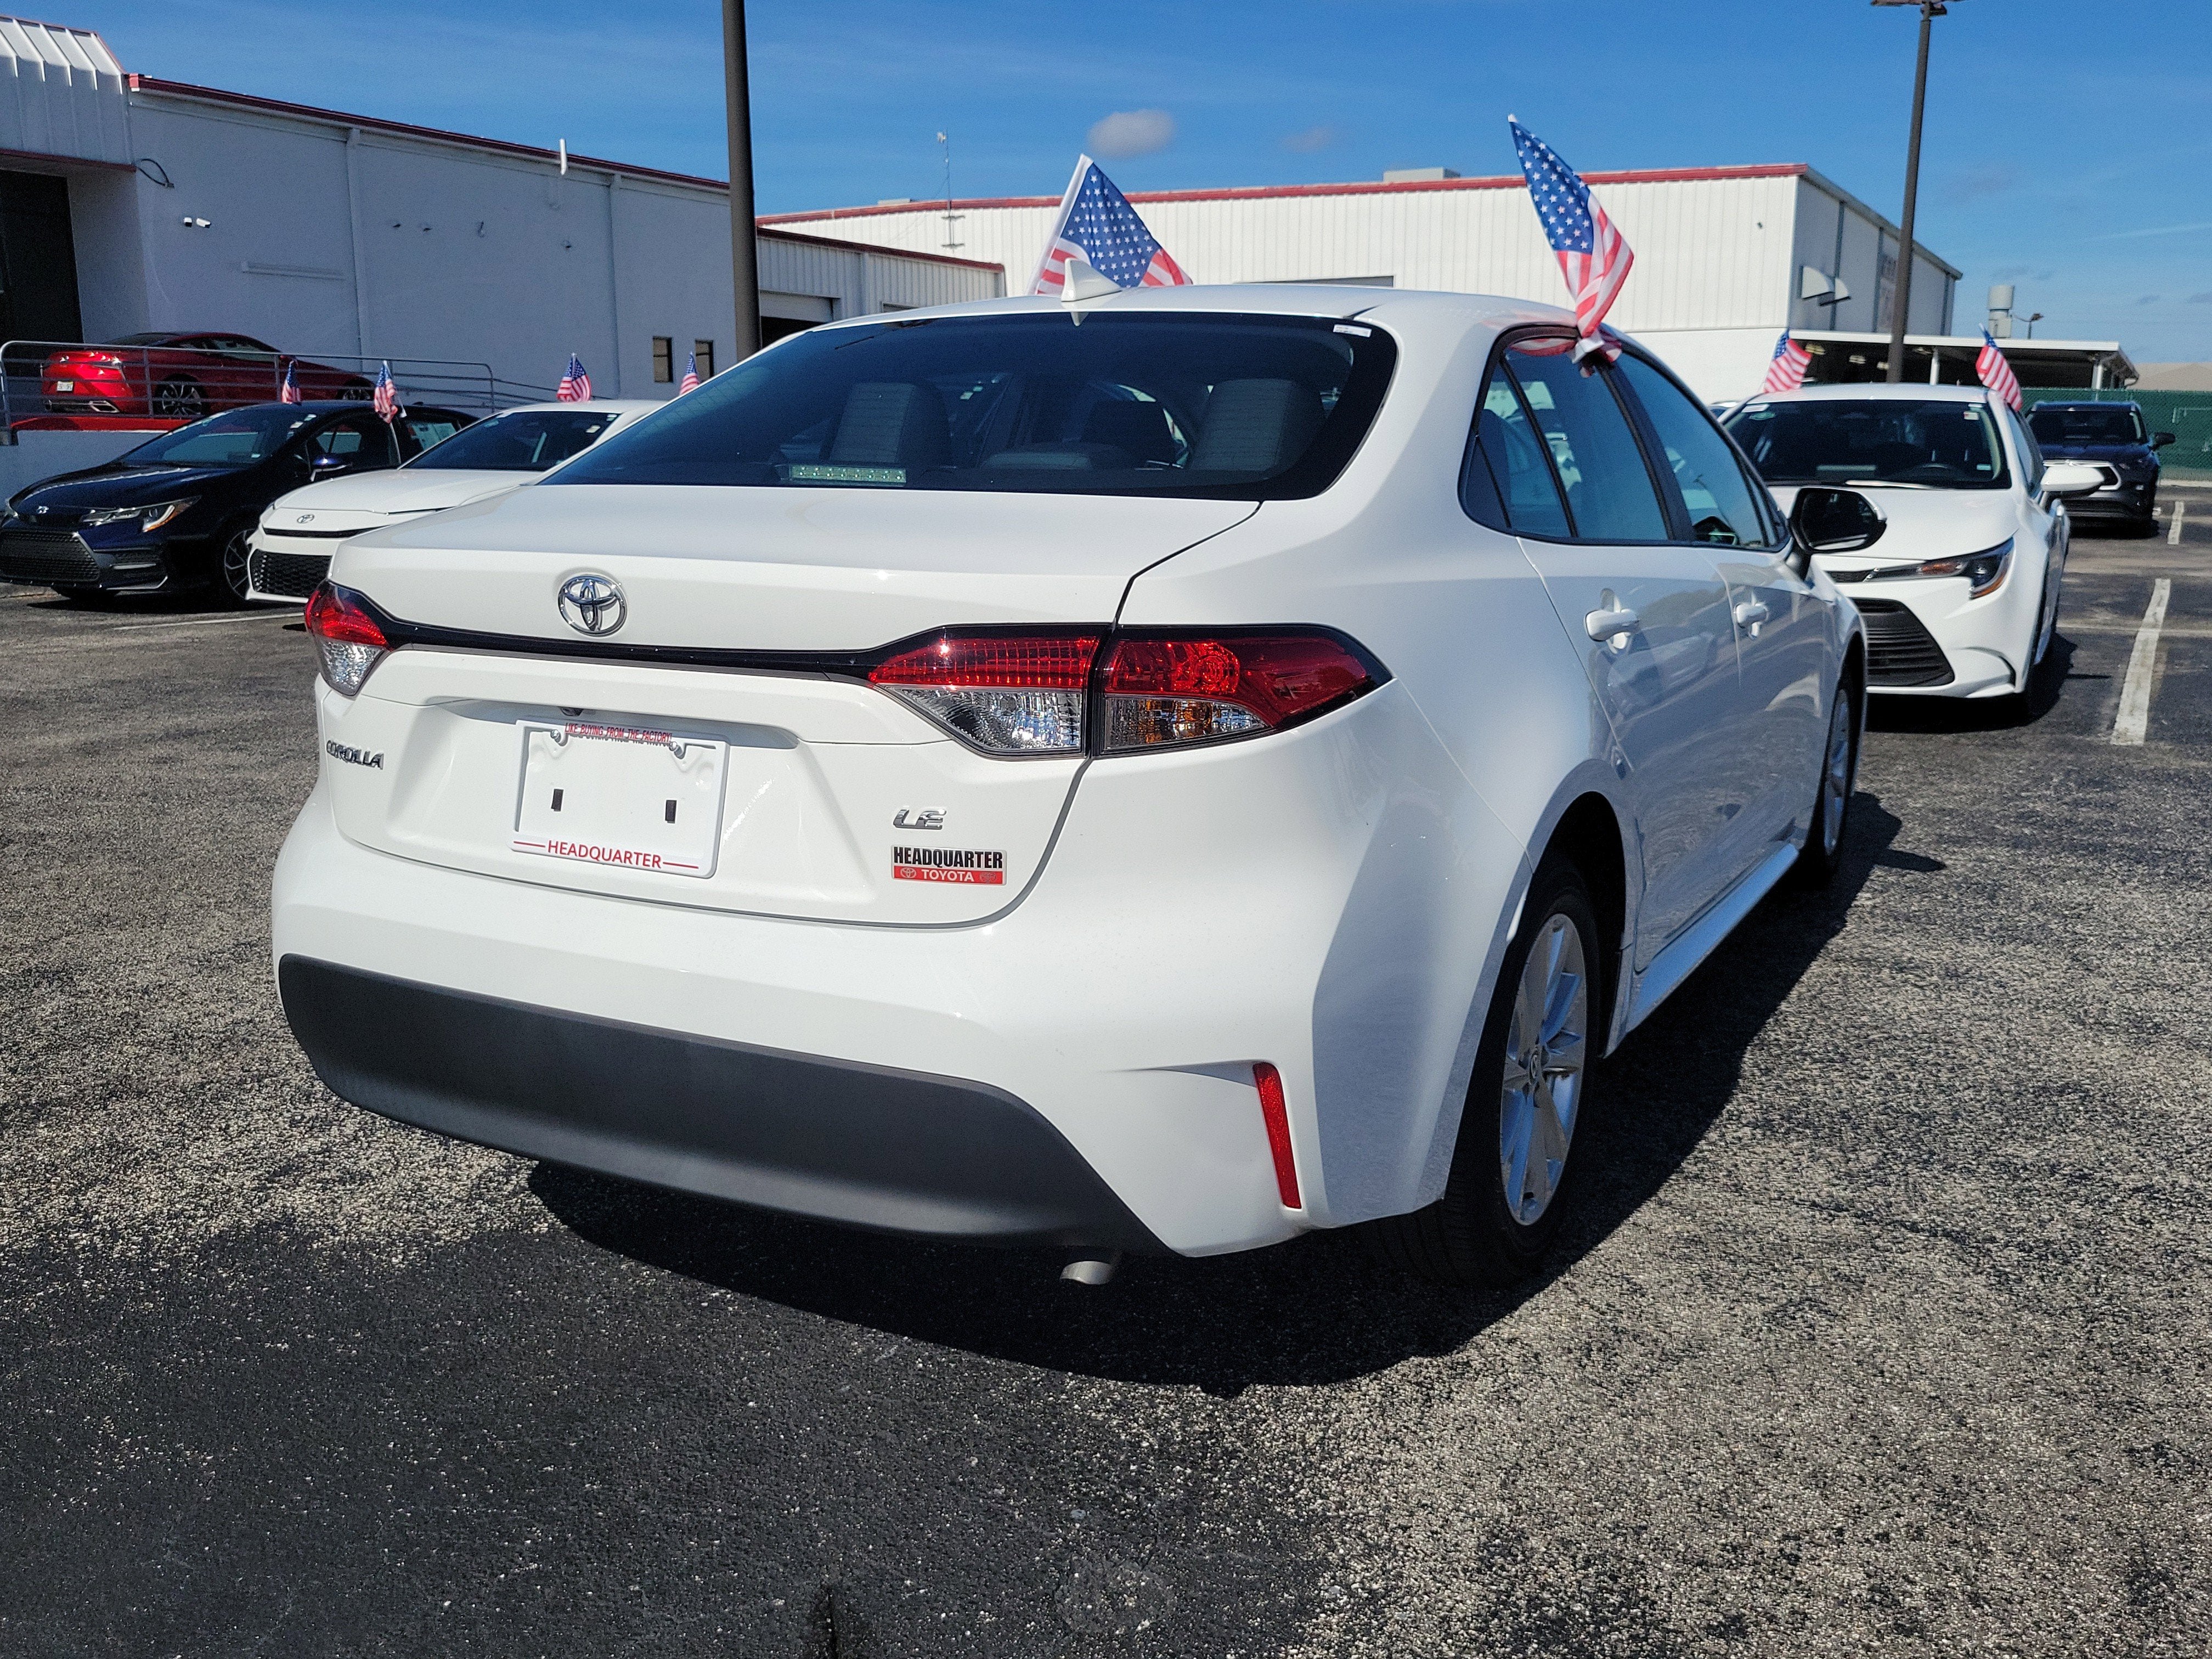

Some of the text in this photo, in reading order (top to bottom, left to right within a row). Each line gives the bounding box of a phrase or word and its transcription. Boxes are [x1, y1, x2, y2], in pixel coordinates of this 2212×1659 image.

[565, 723, 673, 742] LIKE BUYING FROM THE FACTORY!
[326, 740, 384, 770] COROLLA
[893, 809, 946, 830] LE
[548, 840, 663, 868] HEADQUARTER
[894, 847, 1003, 868] HEADQUARTER
[921, 869, 974, 882] TOYOTA
